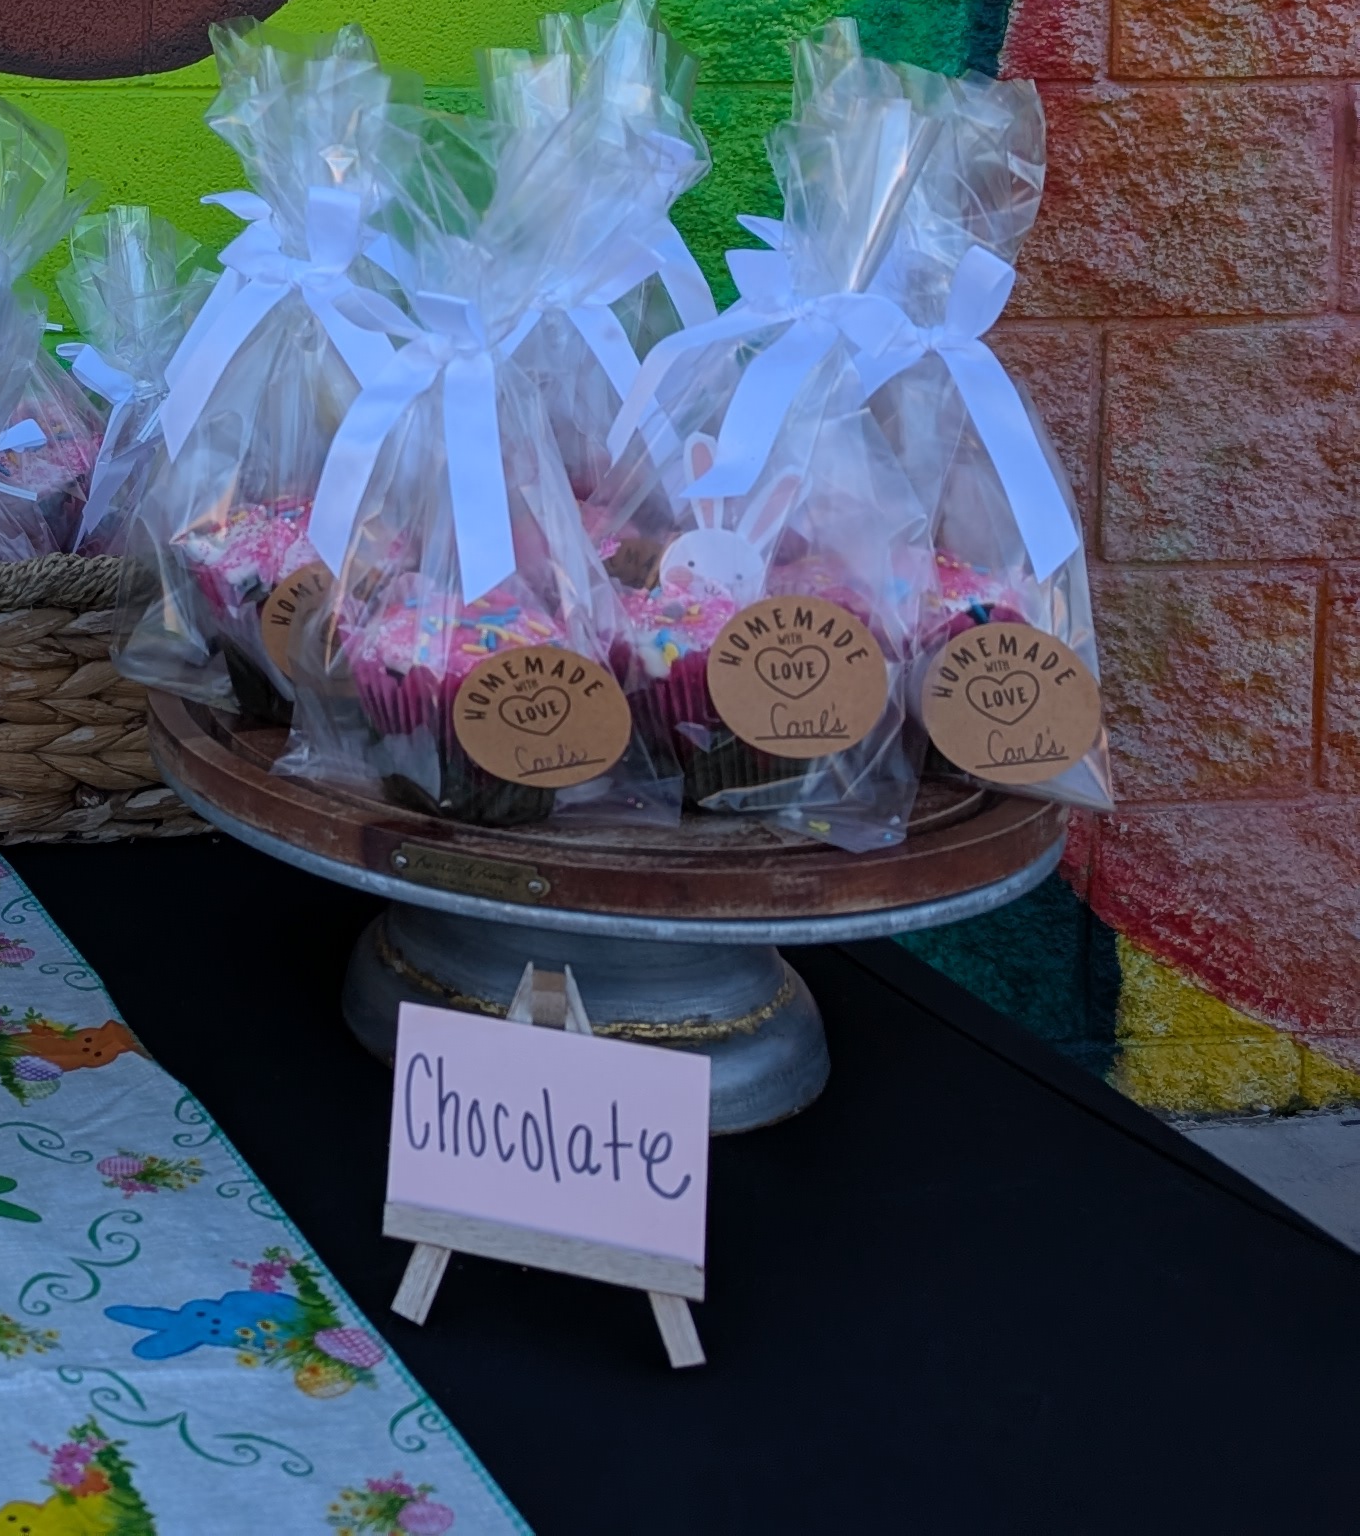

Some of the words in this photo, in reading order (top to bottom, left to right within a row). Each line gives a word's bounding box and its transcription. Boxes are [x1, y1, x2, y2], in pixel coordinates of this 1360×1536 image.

[717, 606, 870, 667] HOMEMADE
[777, 632, 803, 646] WITH
[770, 661, 817, 681] LOVE
[931, 633, 1078, 699] HOMEMADE
[983, 659, 1010, 673] WITH
[463, 655, 605, 721] HOMEMADE
[981, 686, 1028, 710] LOVE
[515, 700, 561, 725] LOVE
[770, 701, 848, 738] Carl's
[987, 725, 1066, 765] Carl's
[405, 1051, 692, 1200] Chocolate
